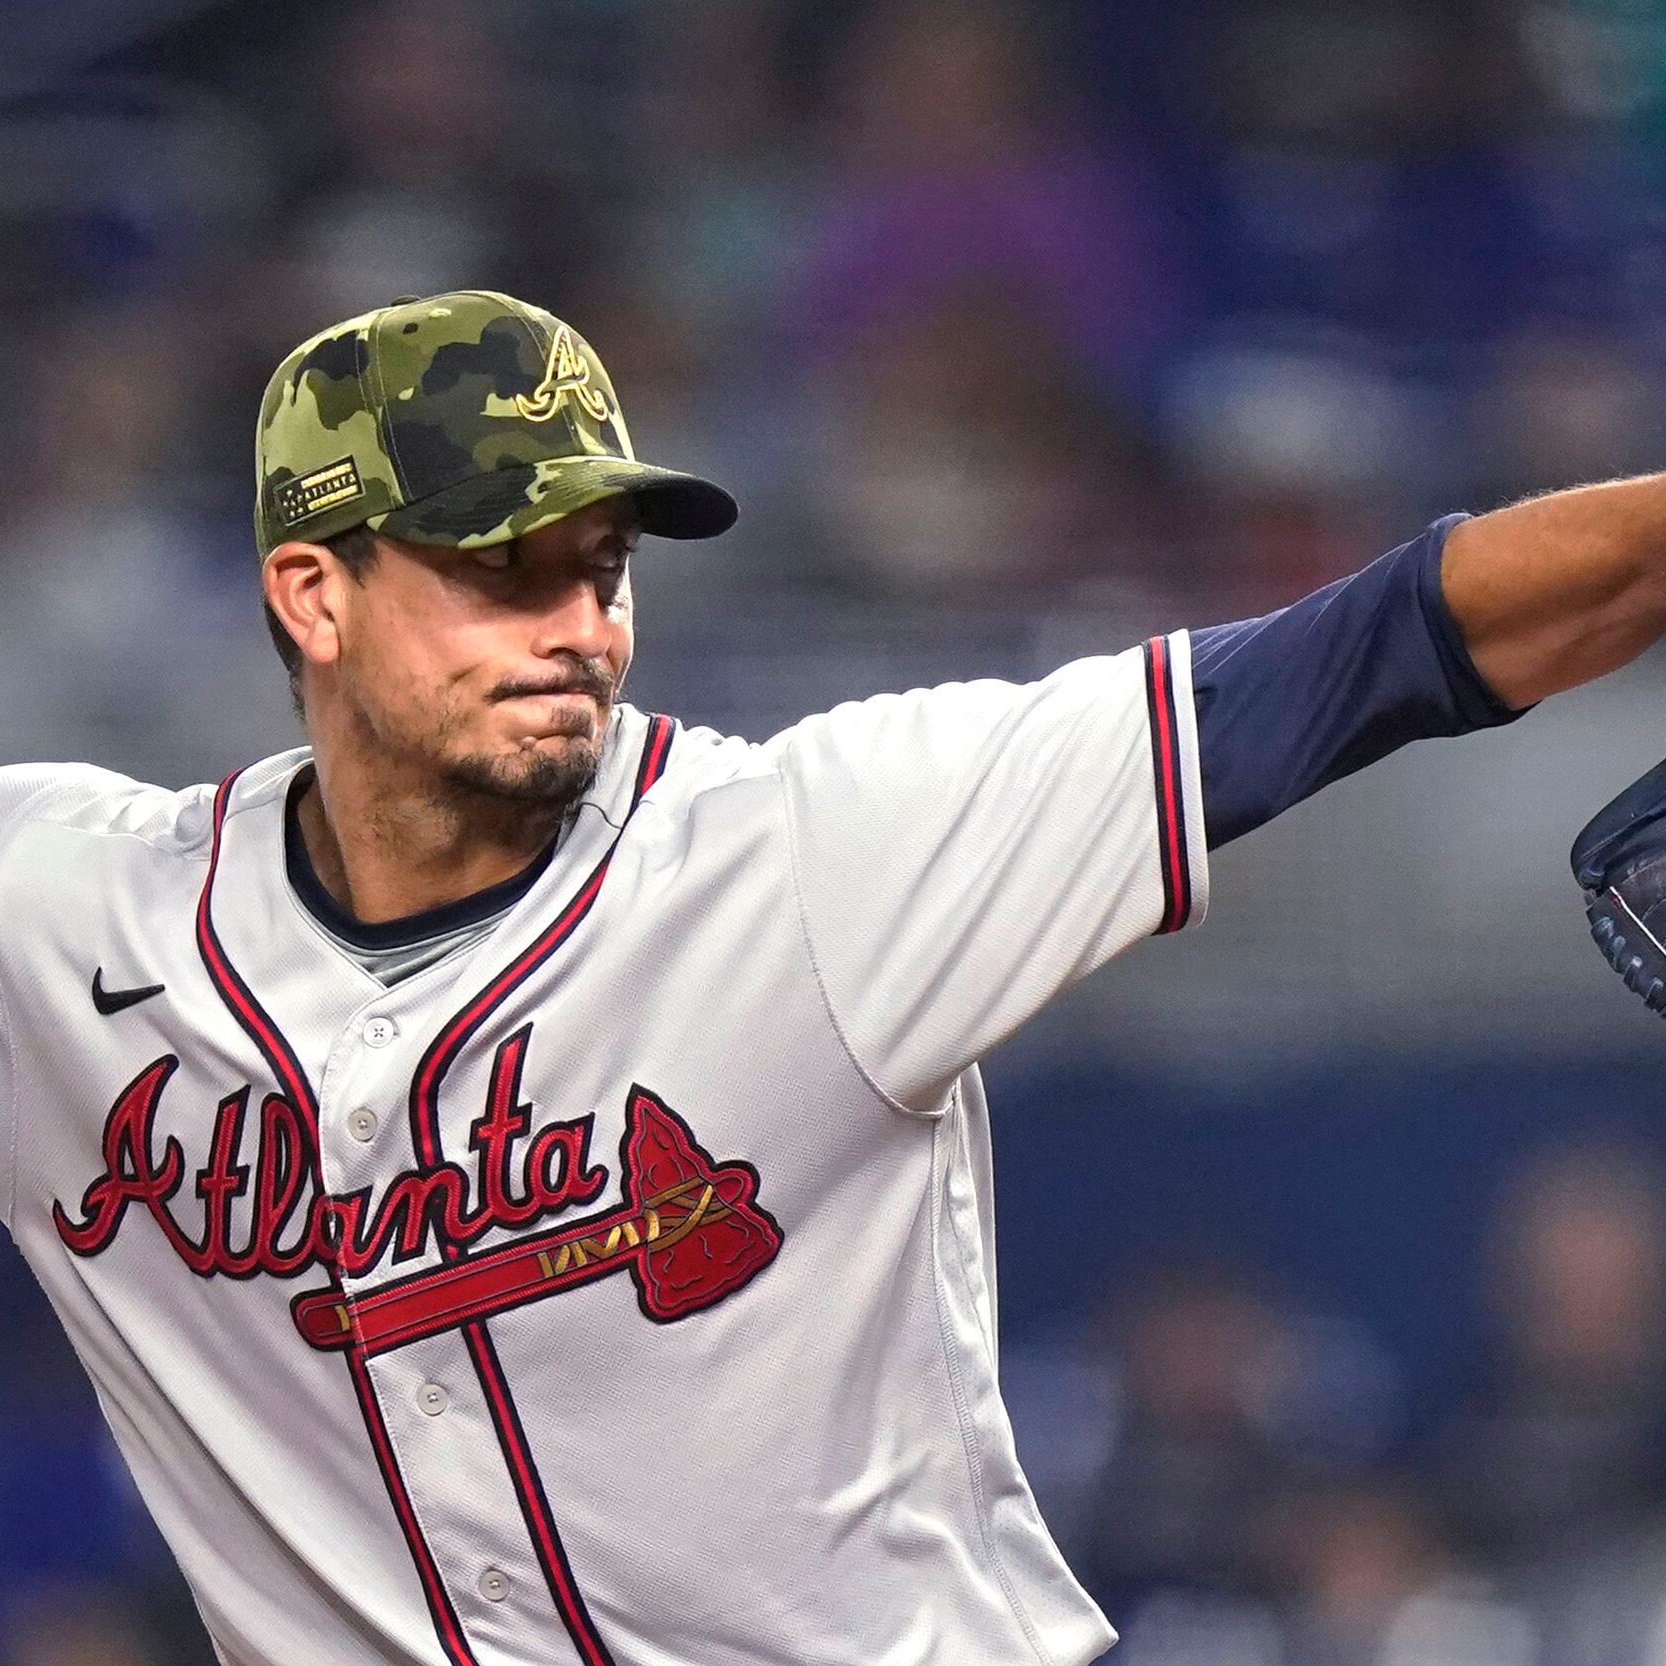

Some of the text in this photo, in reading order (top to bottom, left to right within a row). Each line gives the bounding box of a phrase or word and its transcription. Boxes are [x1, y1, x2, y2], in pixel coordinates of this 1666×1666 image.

[515, 325, 609, 422] A
[304, 473, 357, 500] ATLANTA
[54, 1021, 608, 1281] Atlanta
